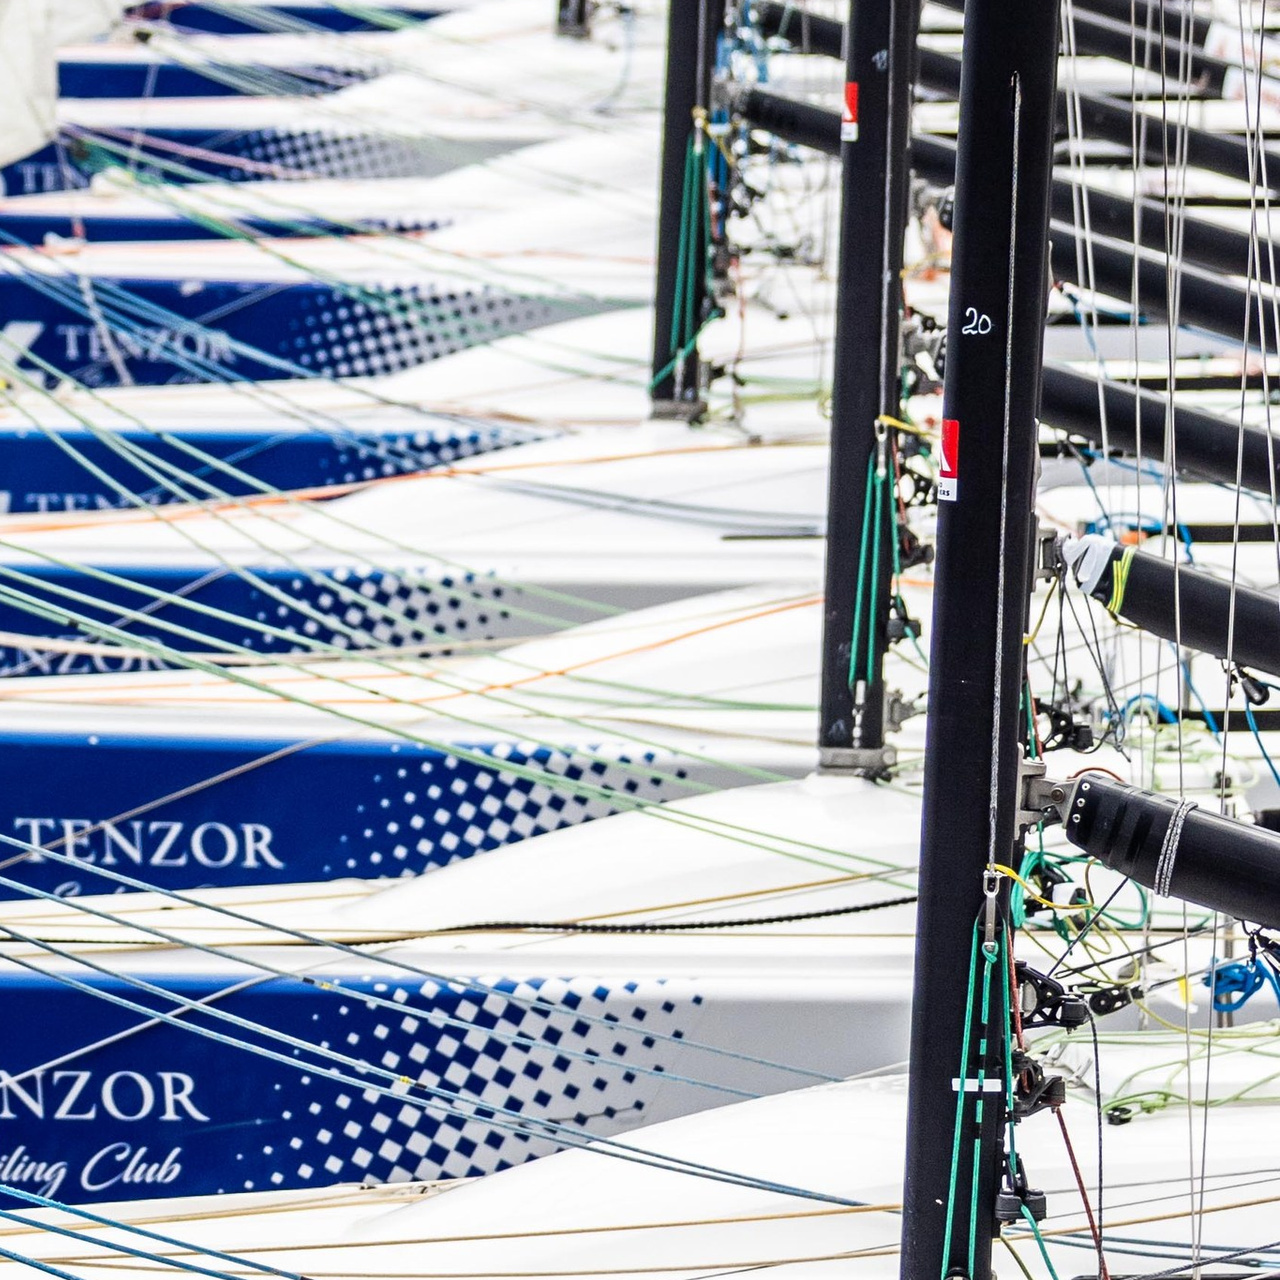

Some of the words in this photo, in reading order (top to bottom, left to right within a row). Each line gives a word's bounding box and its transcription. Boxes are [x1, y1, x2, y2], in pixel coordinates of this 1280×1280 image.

[961, 307, 993, 335] 20
[14, 816, 284, 870] TENZOR
[80, 1142, 182, 1192] Club
